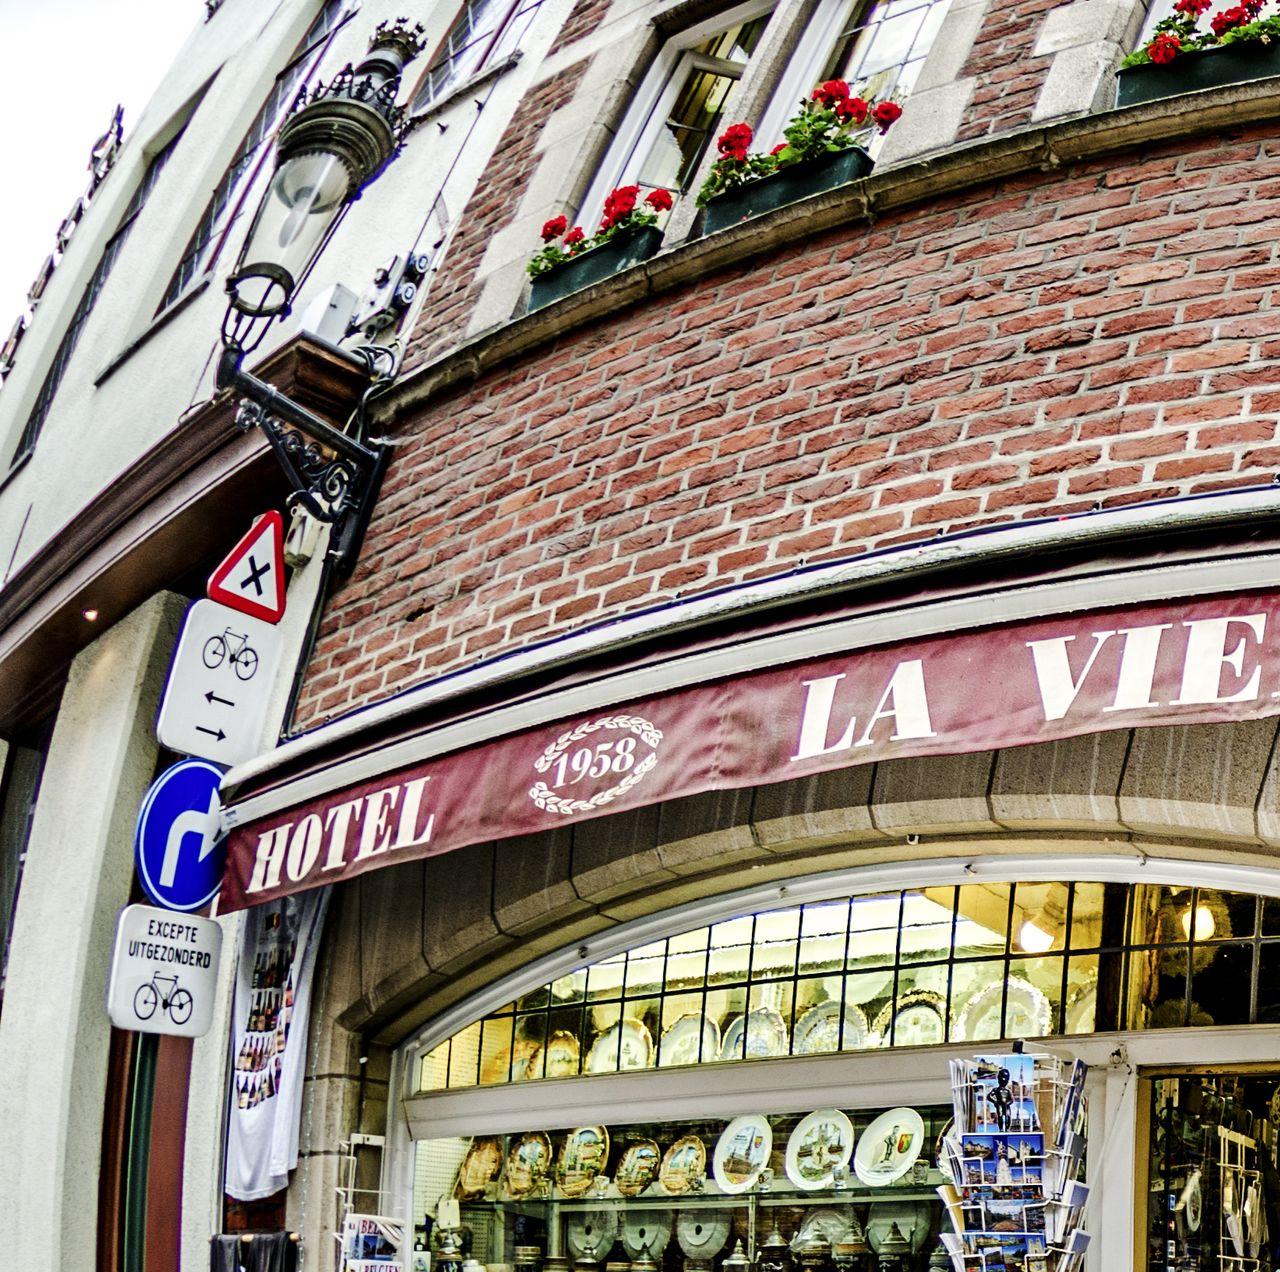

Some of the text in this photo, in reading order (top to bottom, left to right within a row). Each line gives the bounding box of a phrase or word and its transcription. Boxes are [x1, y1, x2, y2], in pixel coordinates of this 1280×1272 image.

[791, 658, 937, 763] LA
[552, 736, 637, 790] 1958
[245, 775, 436, 896] HOTEL
[128, 940, 212, 969] UITGEZONDERD
[148, 919, 199, 943] EXCEPTE
